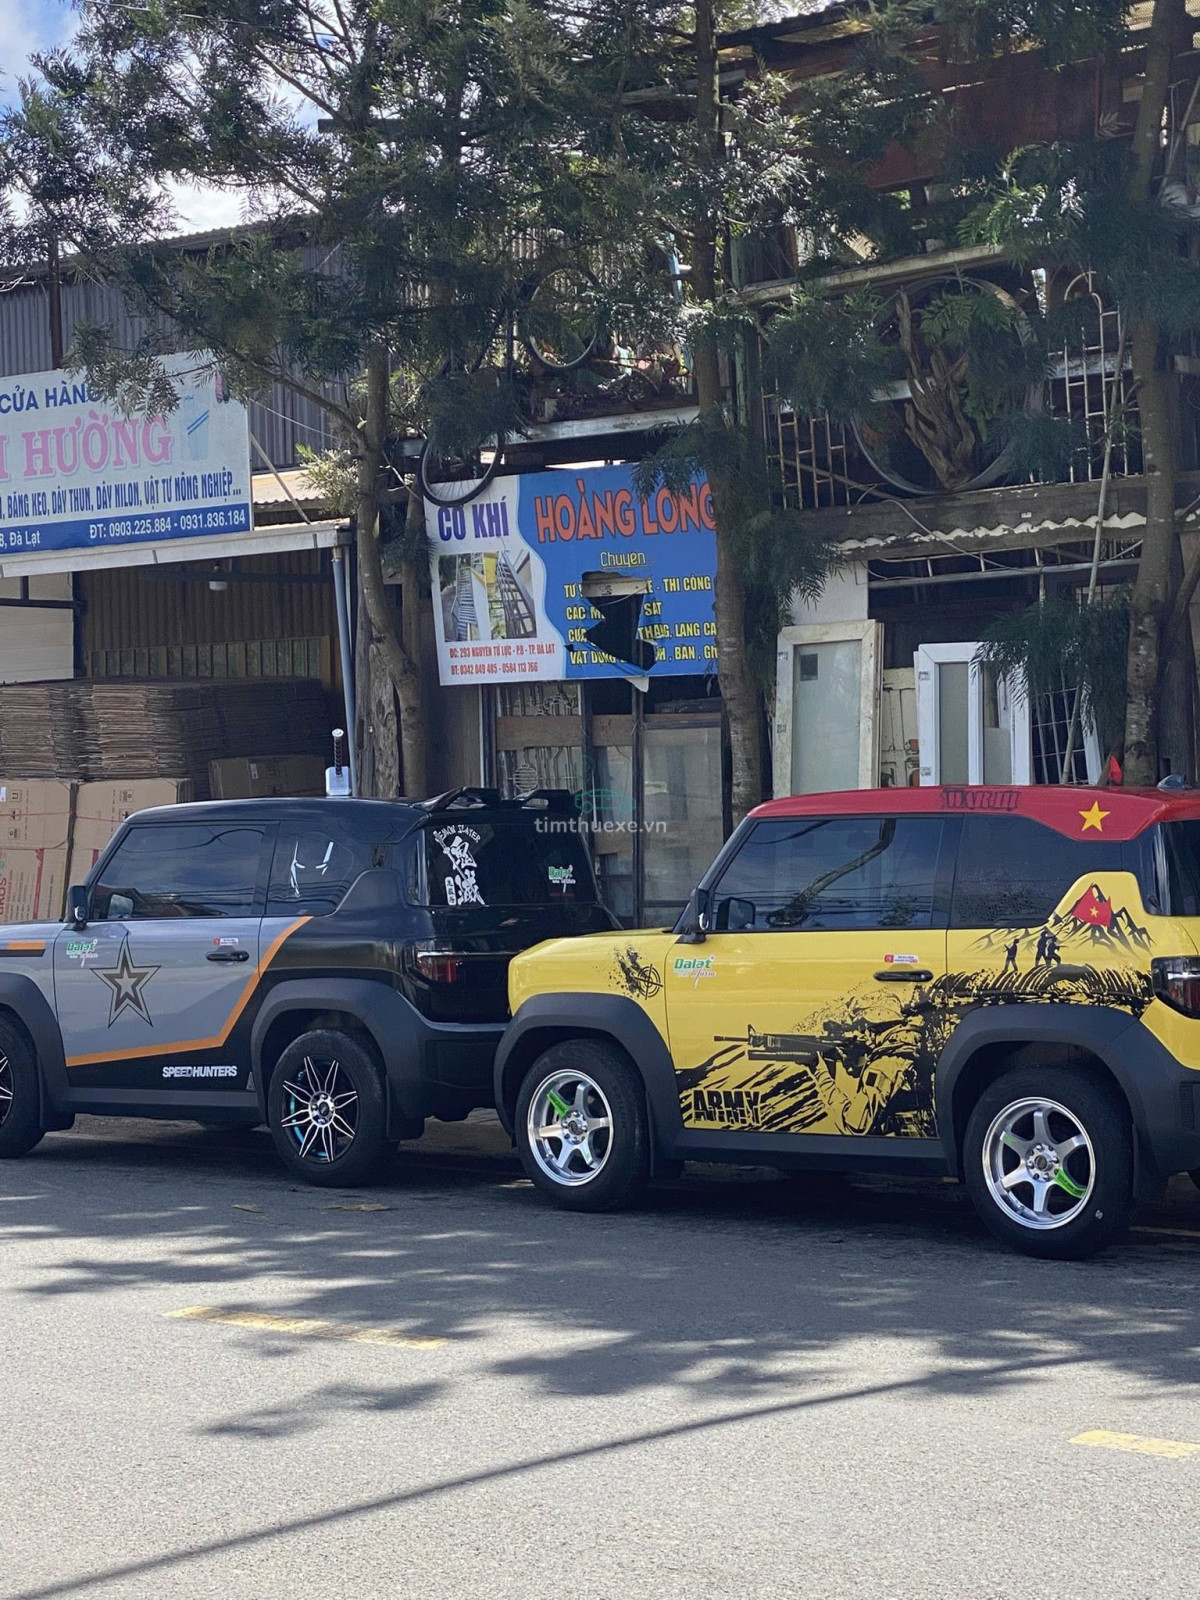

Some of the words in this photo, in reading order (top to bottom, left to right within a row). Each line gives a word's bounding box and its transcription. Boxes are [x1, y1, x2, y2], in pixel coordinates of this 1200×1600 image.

[0, 384, 39, 414] CỬA
[21, 408, 172, 477] HƯỜNG
[7, 490, 30, 519] BĂNG
[51, 485, 67, 515] DÂY
[68, 486, 94, 513] THUN,
[95, 480, 113, 511] DÂY
[114, 480, 143, 509] NILON,
[143, 475, 160, 510] VẬT
[161, 475, 173, 503] TƯ
[174, 471, 199, 502] NÔNG
[534, 478, 636, 543] HOÀNG
[89, 523, 107, 540] ĐT:
[108, 516, 172, 538] 0903.225.884
[180, 508, 246, 531] 0931.836.184
[472, 496, 509, 538] KHÍ
[9, 531, 23, 546] Đà
[24, 529, 41, 547] Lạt
[662, 577, 680, 592] THI
[683, 574, 712, 591] CÔNG
[674, 957, 712, 969] Dalat
[693, 1089, 760, 1124] ARMY
